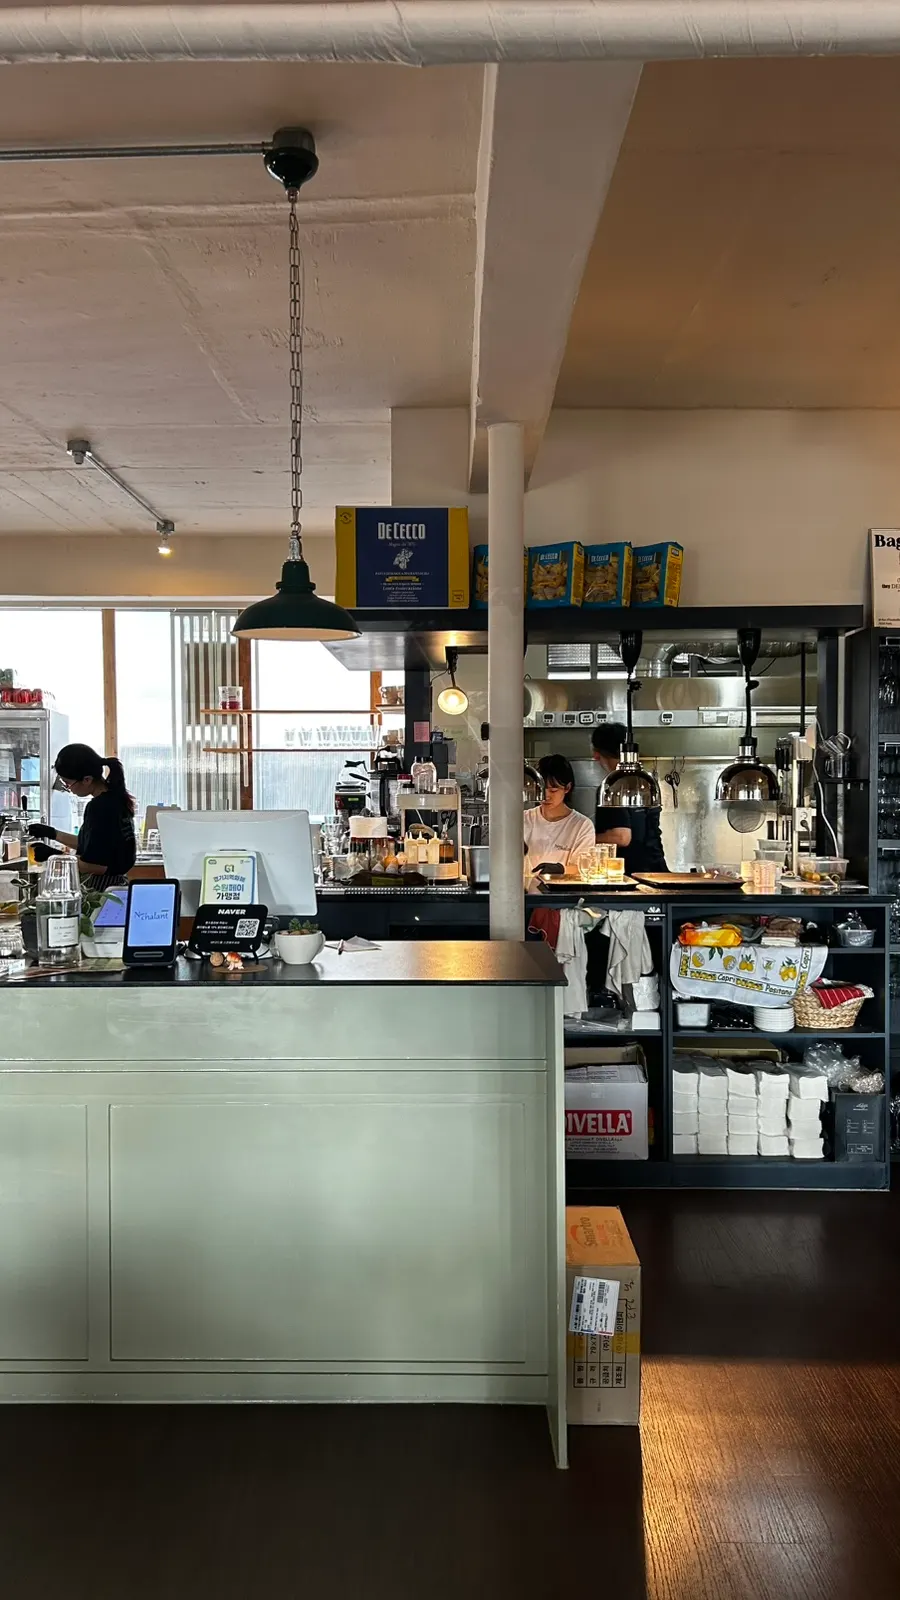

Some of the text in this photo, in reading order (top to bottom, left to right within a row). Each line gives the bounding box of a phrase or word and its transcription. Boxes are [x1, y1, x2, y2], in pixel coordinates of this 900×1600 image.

[213, 883, 244, 892] 수원페이
[216, 892, 240, 901] 가맹점
[717, 973, 736, 984] Capri
[765, 984, 793, 996] Positano
[565, 1113, 629, 1133] IVELLA
